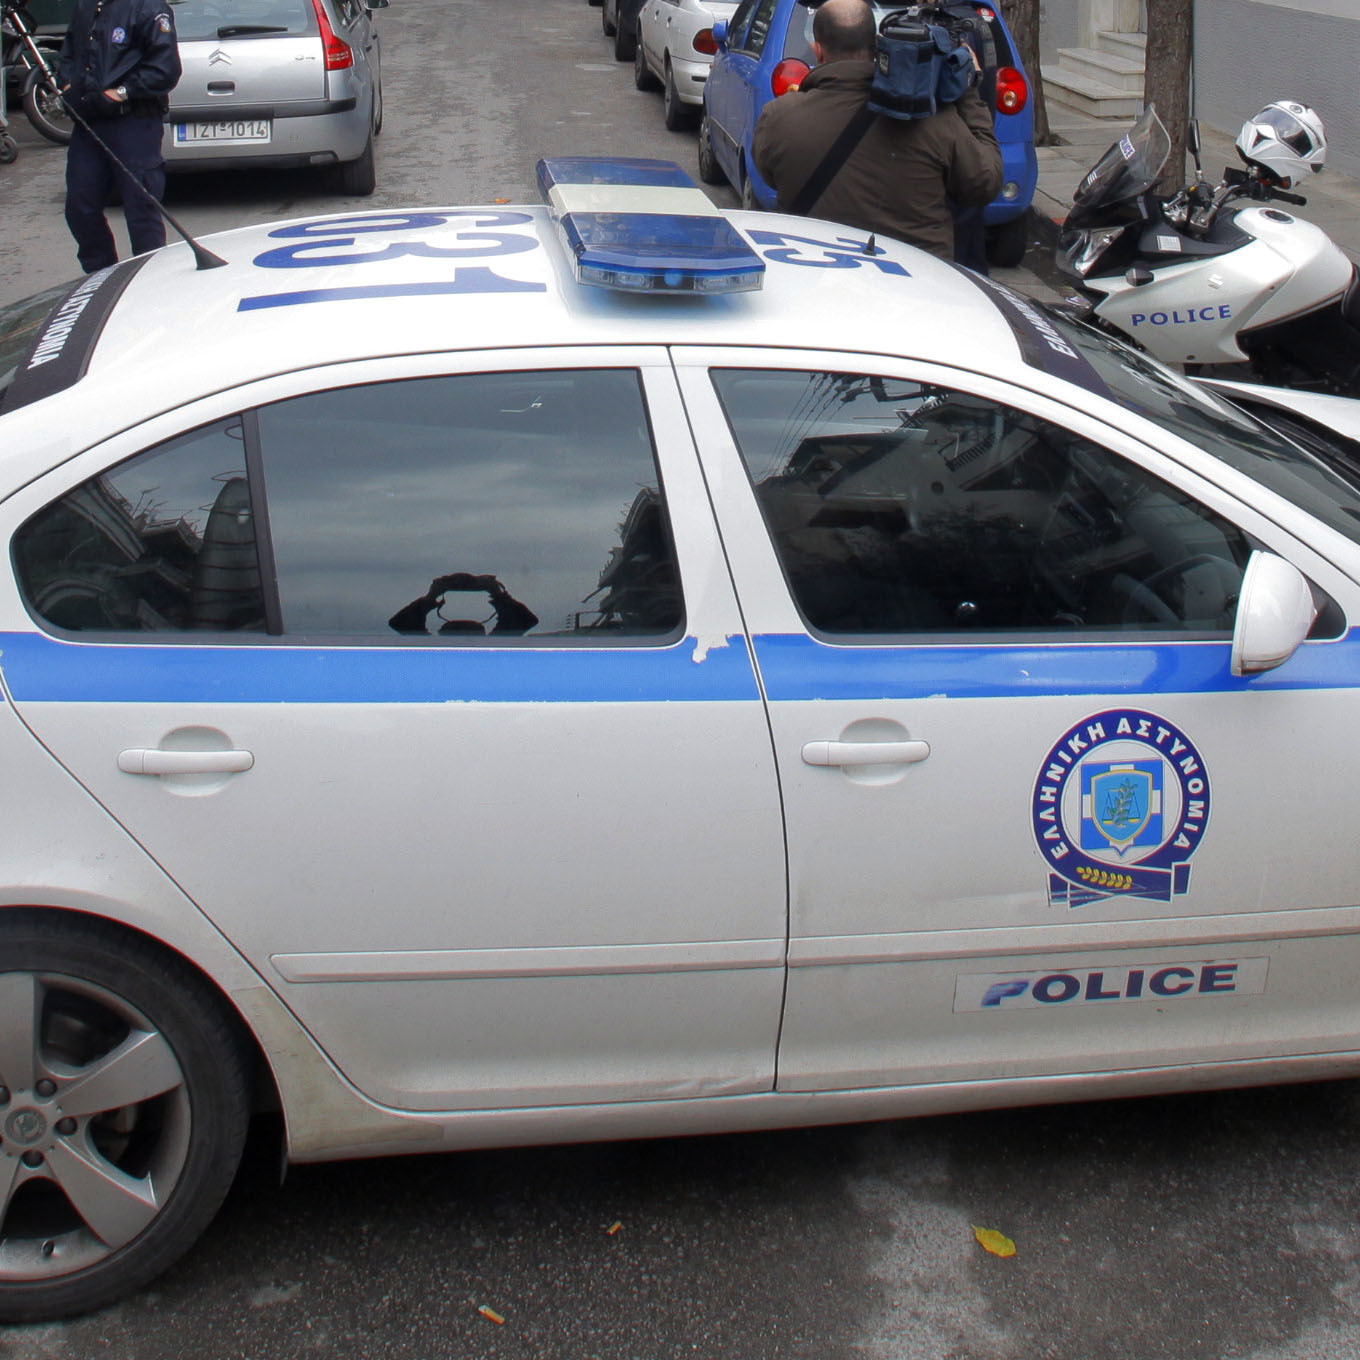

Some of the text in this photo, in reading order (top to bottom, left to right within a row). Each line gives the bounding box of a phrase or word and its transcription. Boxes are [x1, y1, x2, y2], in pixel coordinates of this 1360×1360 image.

[238, 211, 546, 313] 631
[744, 229, 912, 278] 25
[27, 293, 95, 370] ΑΣΤΥΝΟΜΙΑ
[1131, 304, 1232, 327] POLICE
[1039, 716, 1205, 860] ΕΛΛΗΝΙΚΗ ΑΣΤΥΝΟΜΙΑ
[980, 963, 1239, 1009] POLICE
